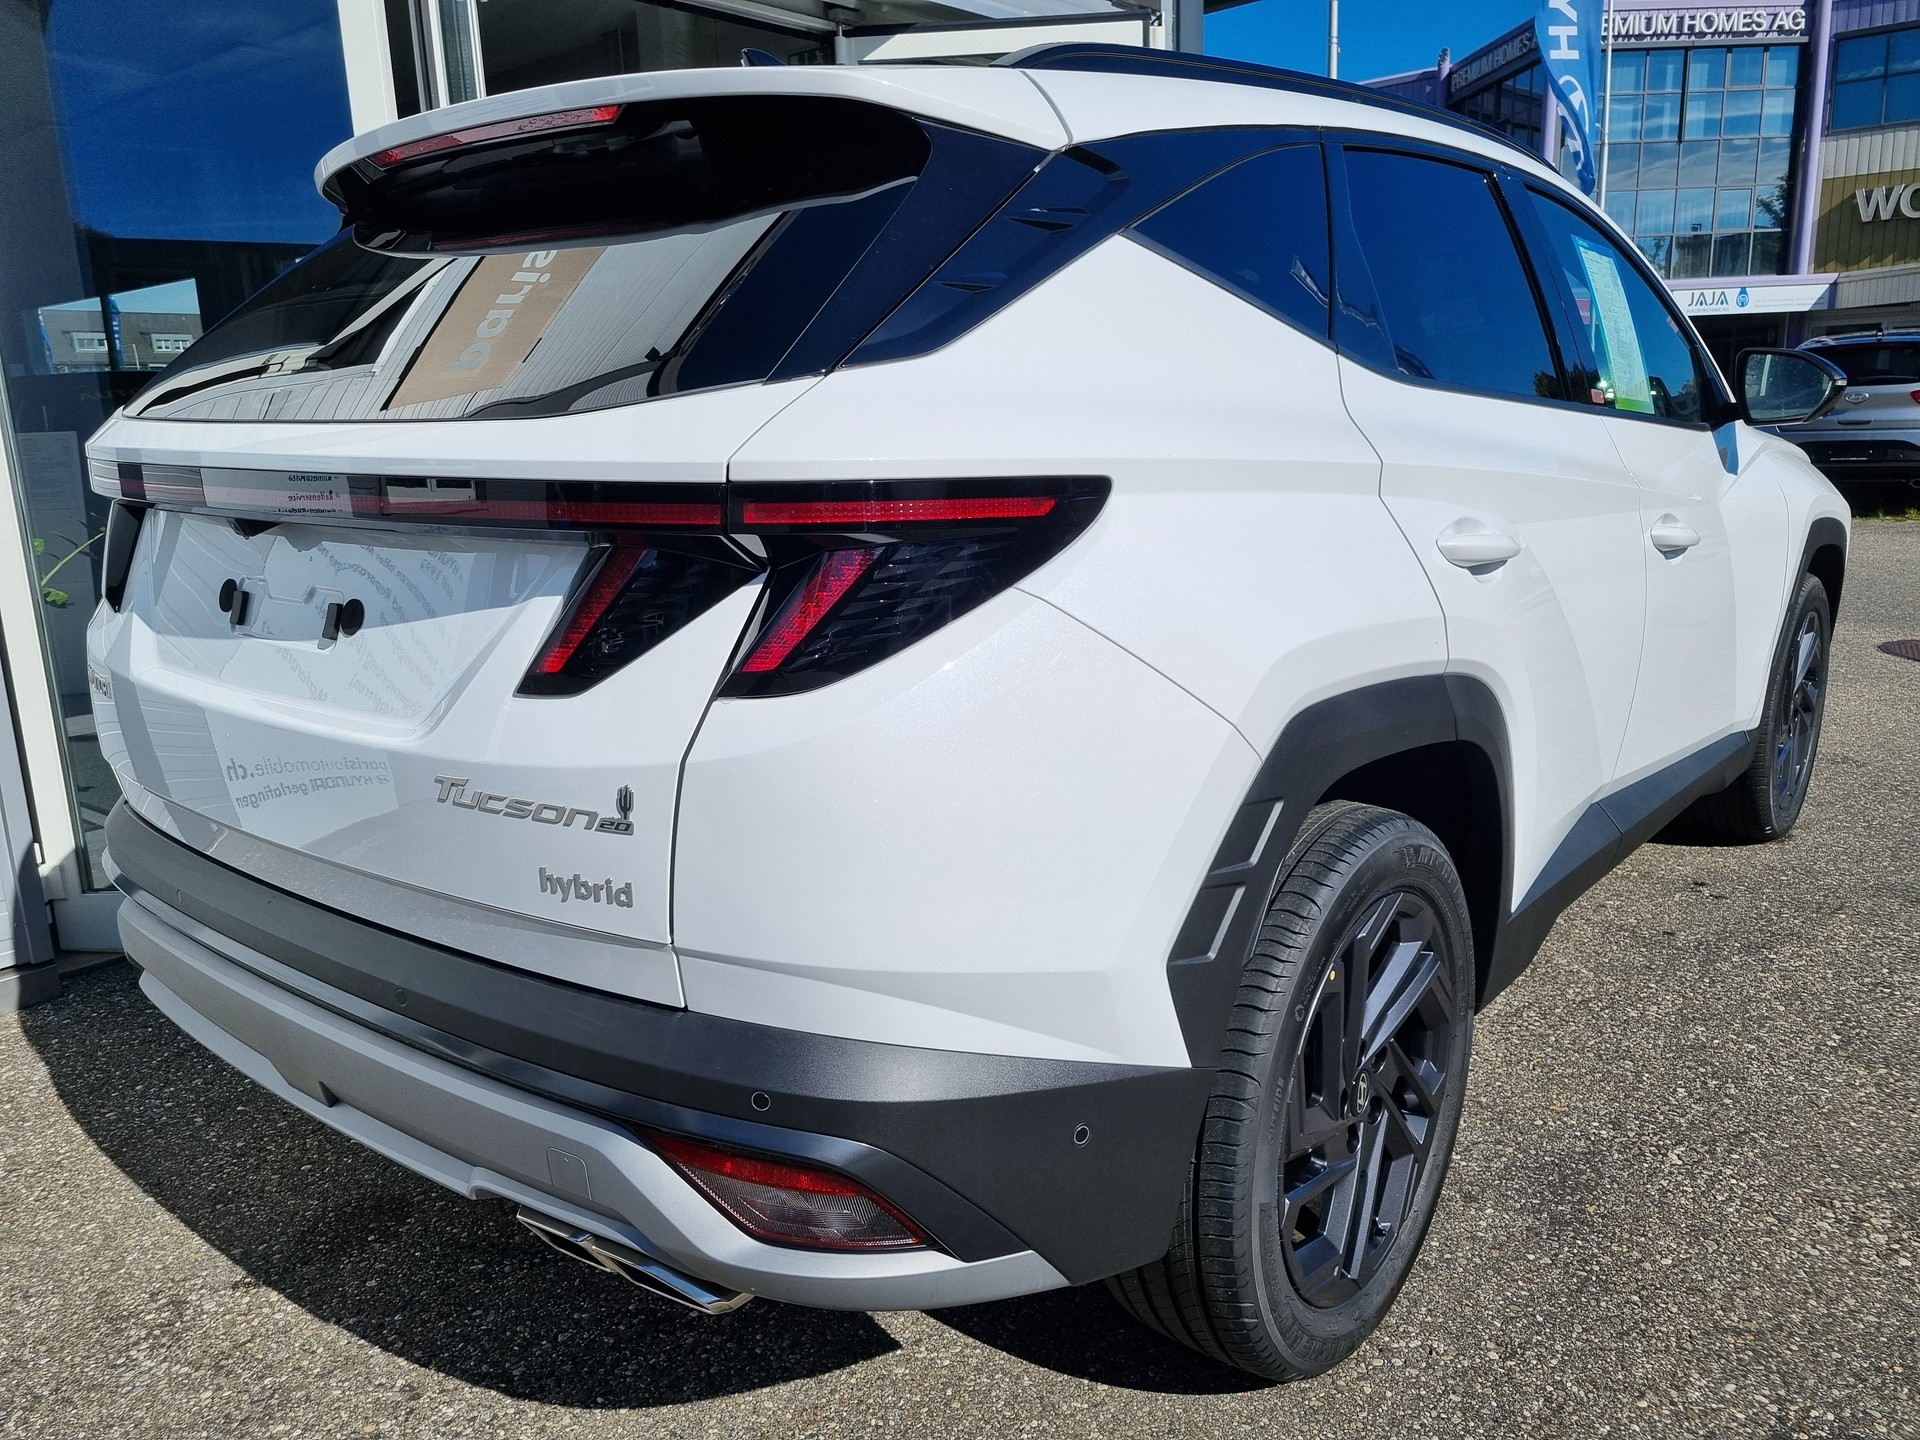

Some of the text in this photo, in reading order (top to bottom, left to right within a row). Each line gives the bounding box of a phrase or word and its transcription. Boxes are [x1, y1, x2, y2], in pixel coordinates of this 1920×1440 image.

[1683, 10, 1766, 33] HOMES
[1772, 8, 1806, 30] AG
[1451, 32, 1531, 92] PREMIUM HOMES
[1688, 291, 1729, 307] JAJA
[598, 819, 632, 832] 20
[538, 866, 634, 909] hybrid
